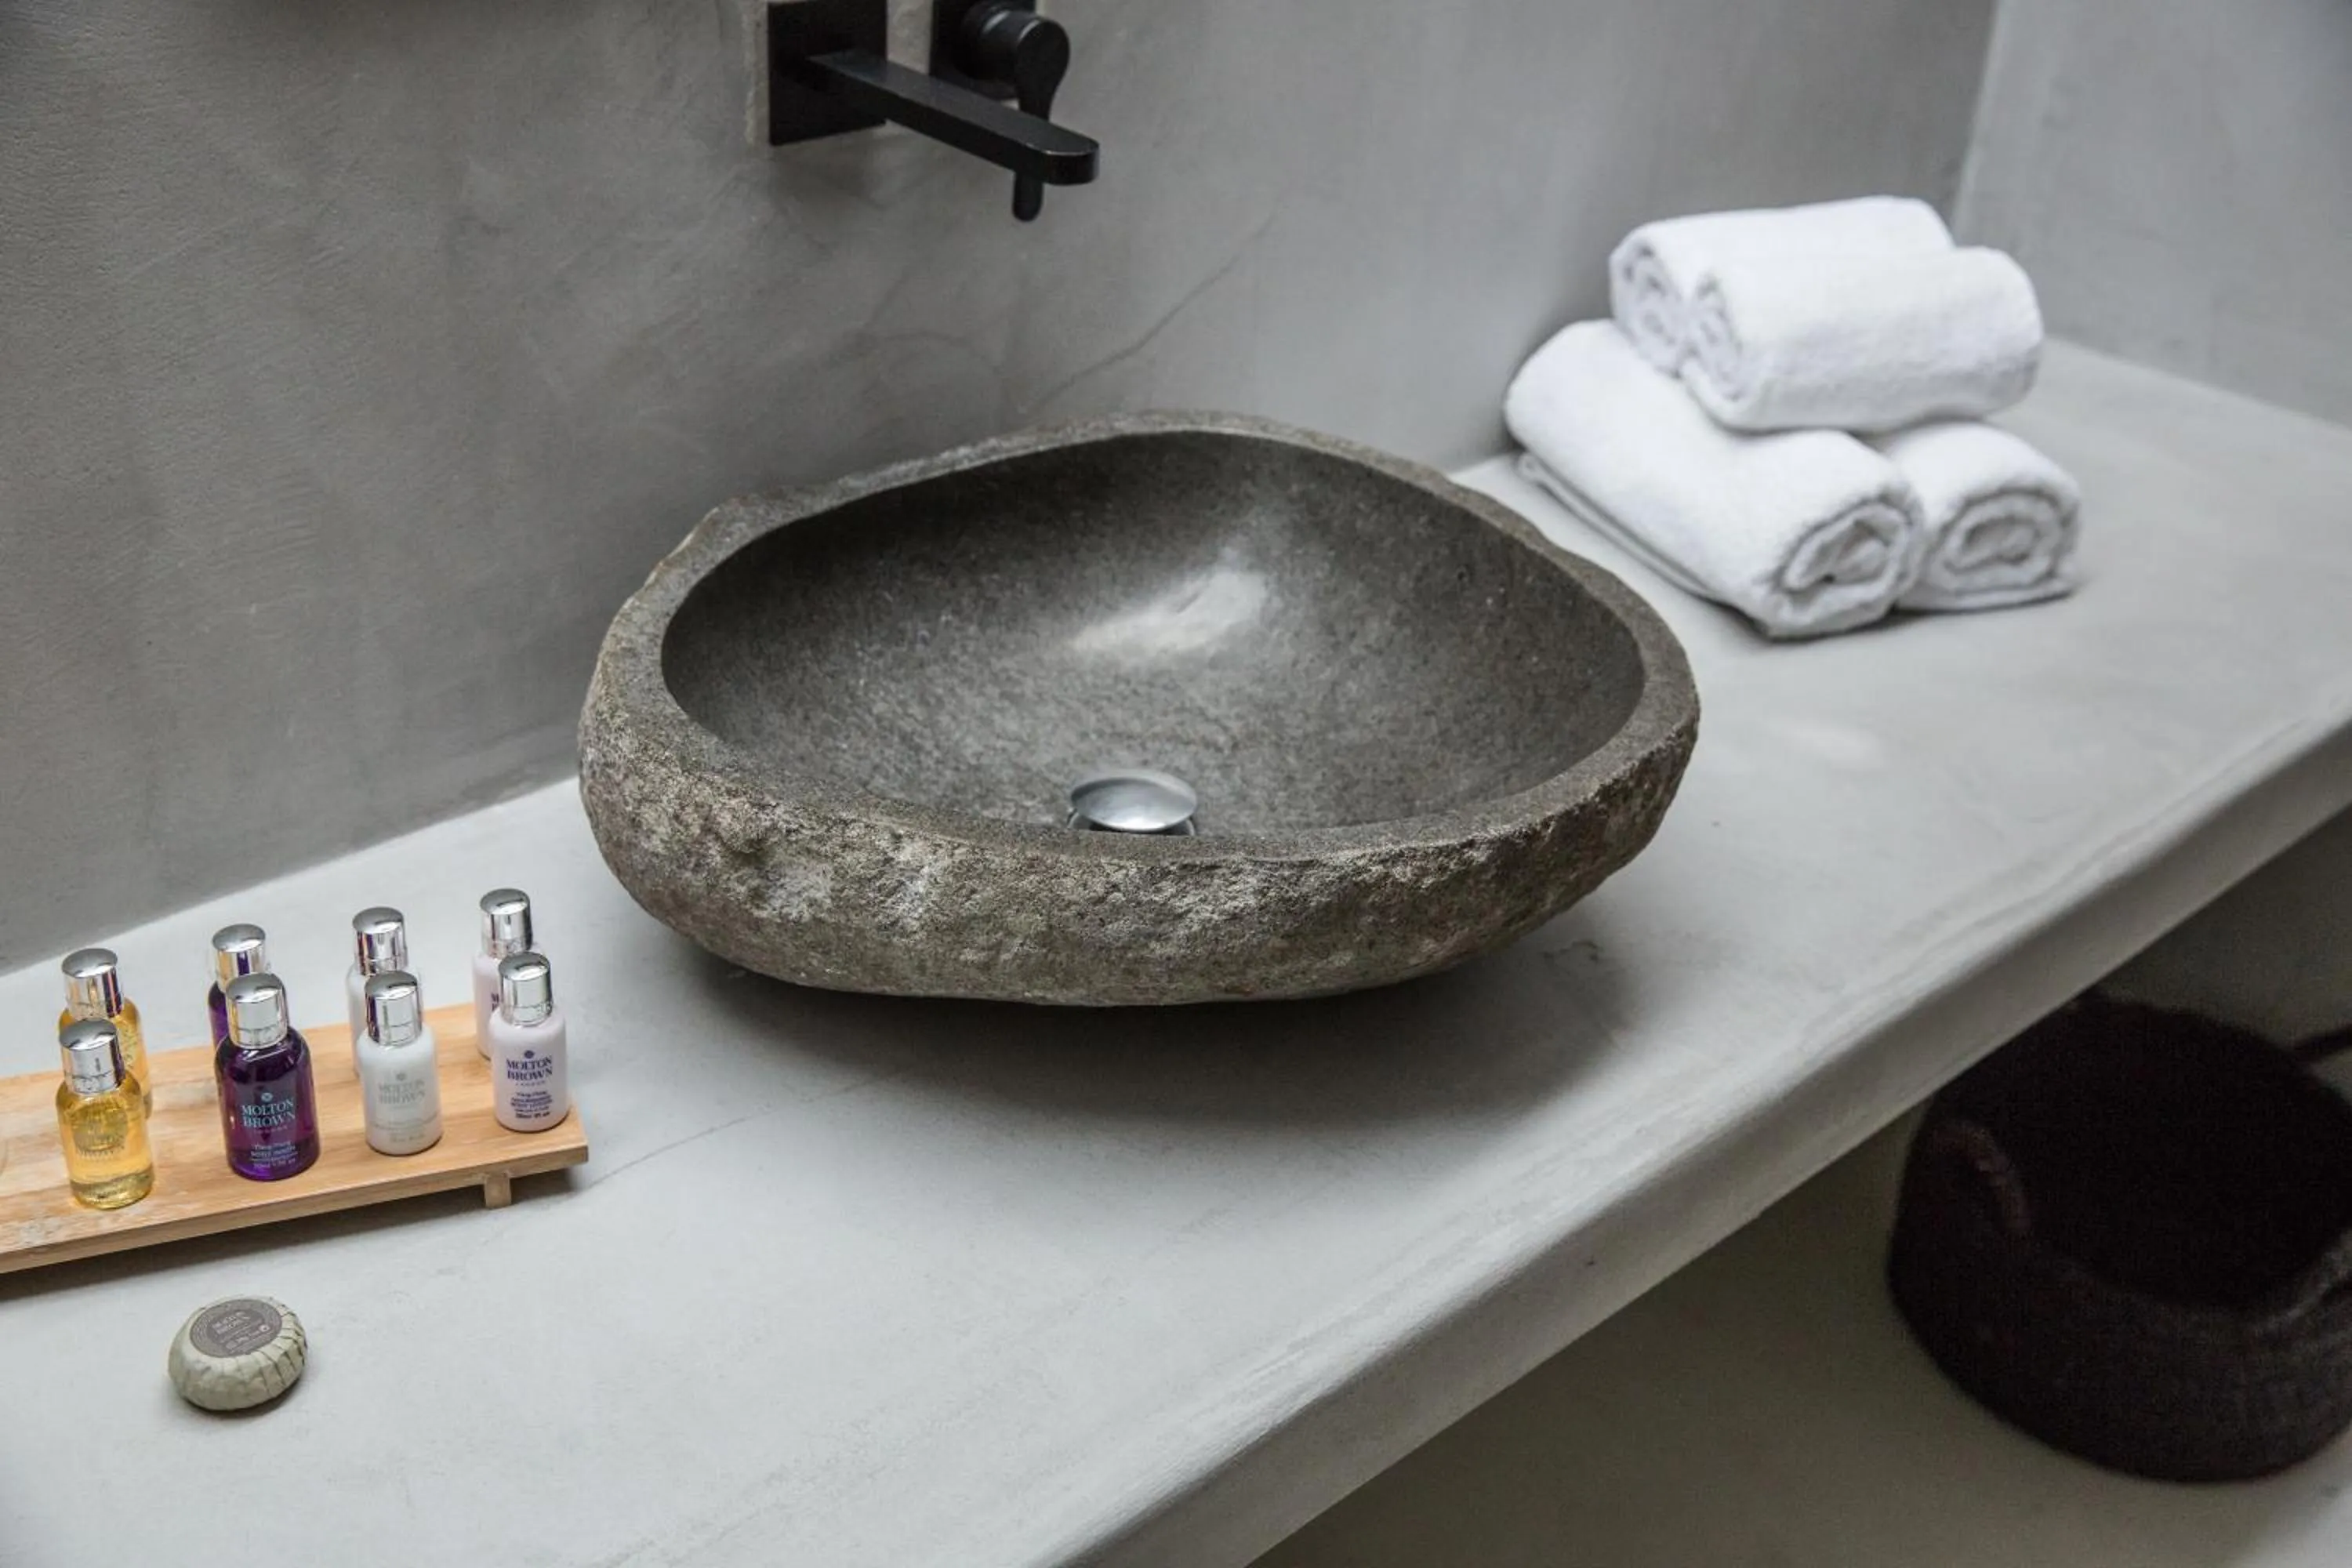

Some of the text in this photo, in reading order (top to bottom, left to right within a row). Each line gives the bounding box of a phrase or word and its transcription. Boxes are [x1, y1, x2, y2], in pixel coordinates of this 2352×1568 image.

[506, 1056, 552, 1070] MOLTON
[507, 1066, 553, 1080] BROWN
[241, 1098, 294, 1115] MOLTON
[243, 1111, 296, 1127] BROWN
